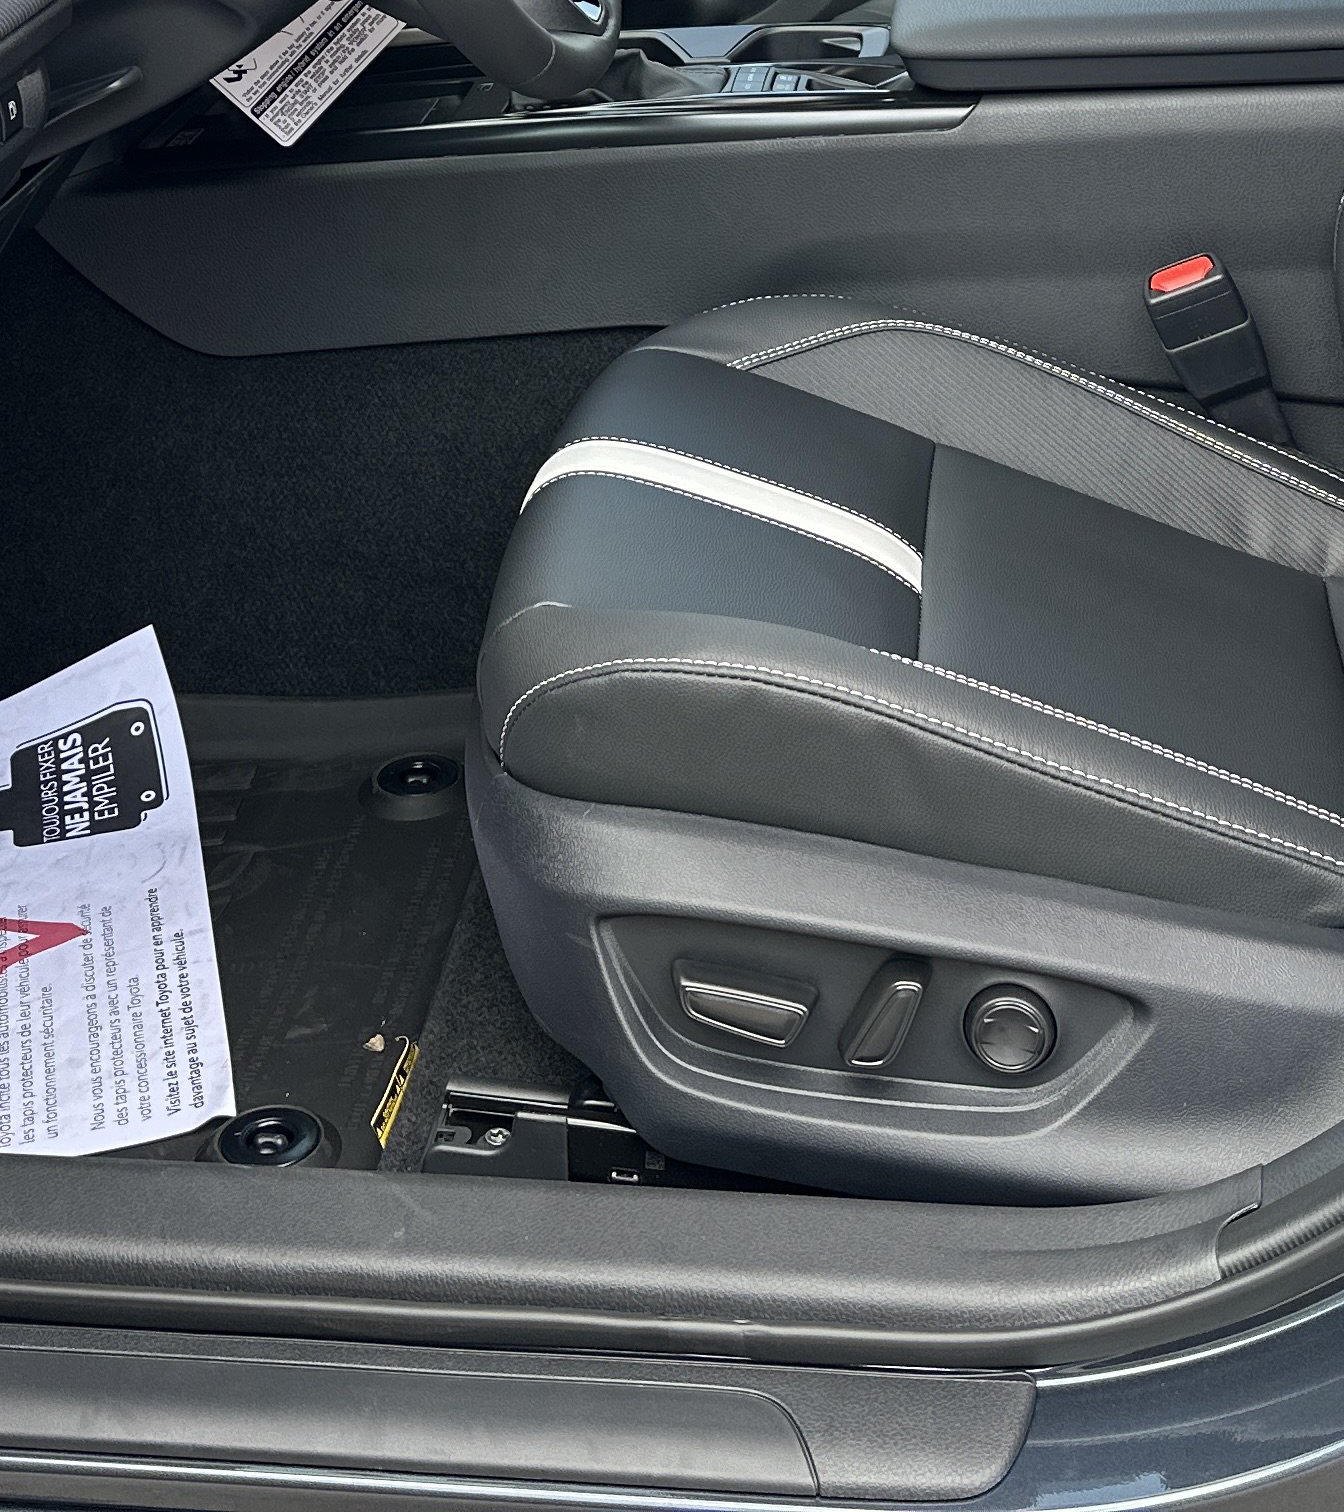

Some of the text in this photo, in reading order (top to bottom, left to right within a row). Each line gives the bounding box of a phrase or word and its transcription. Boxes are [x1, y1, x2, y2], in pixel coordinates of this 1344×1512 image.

[253, 91, 277, 114] Stopping
[341, 0, 363, 22] emergen
[36, 739, 63, 843] TOUJOURS FIXER
[56, 731, 90, 810] JAMAIS
[87, 737, 119, 821] EMPILER
[15, 936, 33, 958] pour
[78, 937, 93, 951] de
[12, 958, 31, 999] véhicule
[80, 952, 96, 992] discuter
[83, 993, 97, 1001] à
[16, 1000, 32, 1022] leur
[98, 905, 129, 1126] des tapis protecteurs avec un représentant de
[144, 887, 182, 1116] Visitez le site internet Toyota pour en apprendre
[170, 929, 205, 1109] davantage au sujet de votre véhicule.
[16, 1022, 32, 1037] de
[86, 1002, 103, 1074] encourageons
[126, 976, 152, 1122] votre concessionnaire Toyota.
[19, 1038, 36, 1099] protecteurs
[39, 985, 59, 1139] un fonctionnement sécuritaire.
[90, 1075, 104, 1101] vous
[19, 1128, 36, 1145] les
[20, 1100, 38, 1128] tapis
[90, 1102, 105, 1131] Nous
